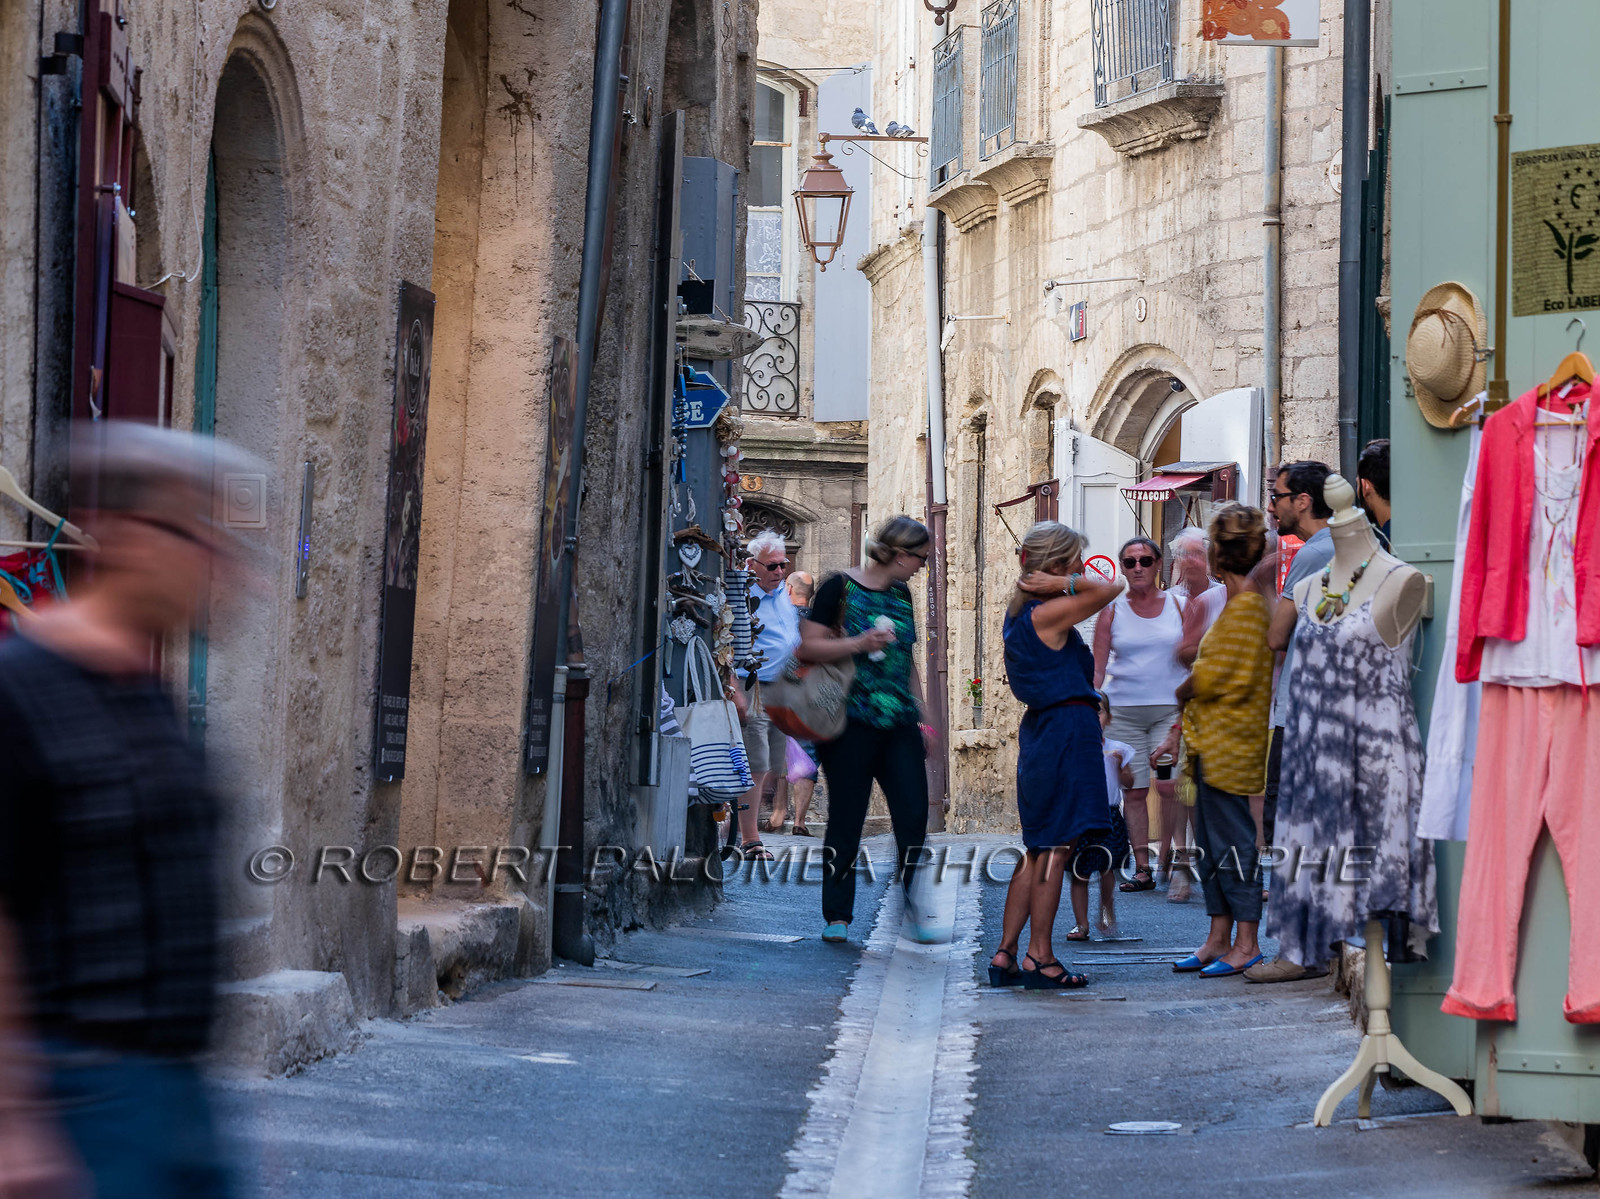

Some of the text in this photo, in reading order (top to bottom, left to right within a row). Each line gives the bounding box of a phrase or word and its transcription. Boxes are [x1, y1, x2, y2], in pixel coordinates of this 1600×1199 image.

[1516, 154, 1558, 166] EUROPEAN
[1560, 151, 1587, 161] UNION
[1544, 298, 1564, 311] Eco
